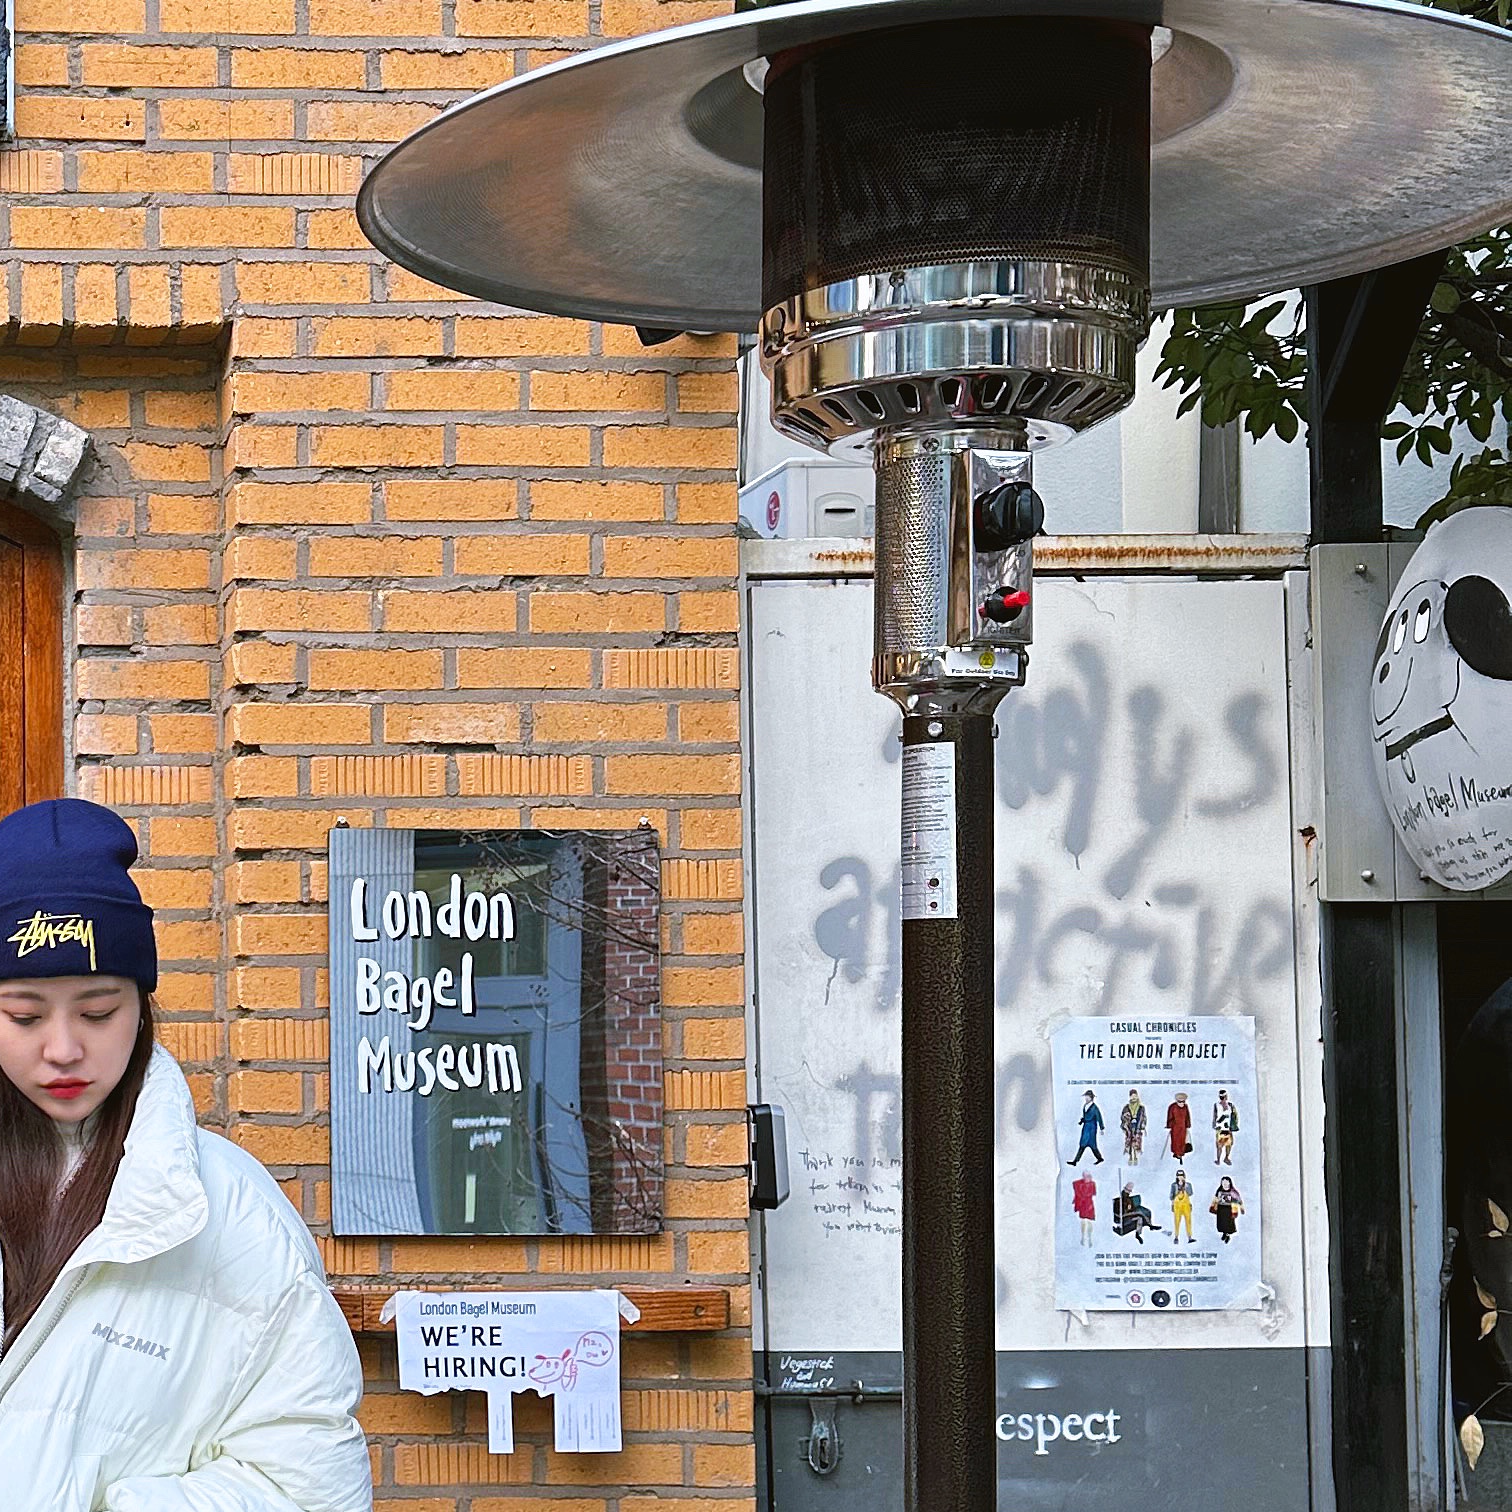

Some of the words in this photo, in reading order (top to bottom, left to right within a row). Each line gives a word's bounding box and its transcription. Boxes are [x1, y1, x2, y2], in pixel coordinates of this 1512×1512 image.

[350, 873, 516, 942] London
[355, 952, 475, 1031] Bagel
[1110, 1022, 1143, 1033] CASUAL
[1145, 1022, 1197, 1033] CHRONICLES
[1080, 1043, 1104, 1059] THE
[1110, 1043, 1163, 1059] LONDON
[1169, 1043, 1228, 1059] PROJECT
[357, 1035, 523, 1096] Museum
[842, 1156, 864, 1169] you
[419, 1301, 458, 1316] London
[460, 1301, 489, 1318] Bagel
[491, 1302, 537, 1316] Museum
[91, 1322, 171, 1361] MIX2MIX
[421, 1324, 503, 1347] WE'RE
[423, 1355, 527, 1379] HIRING!
[995, 1408, 1122, 1456] espect
